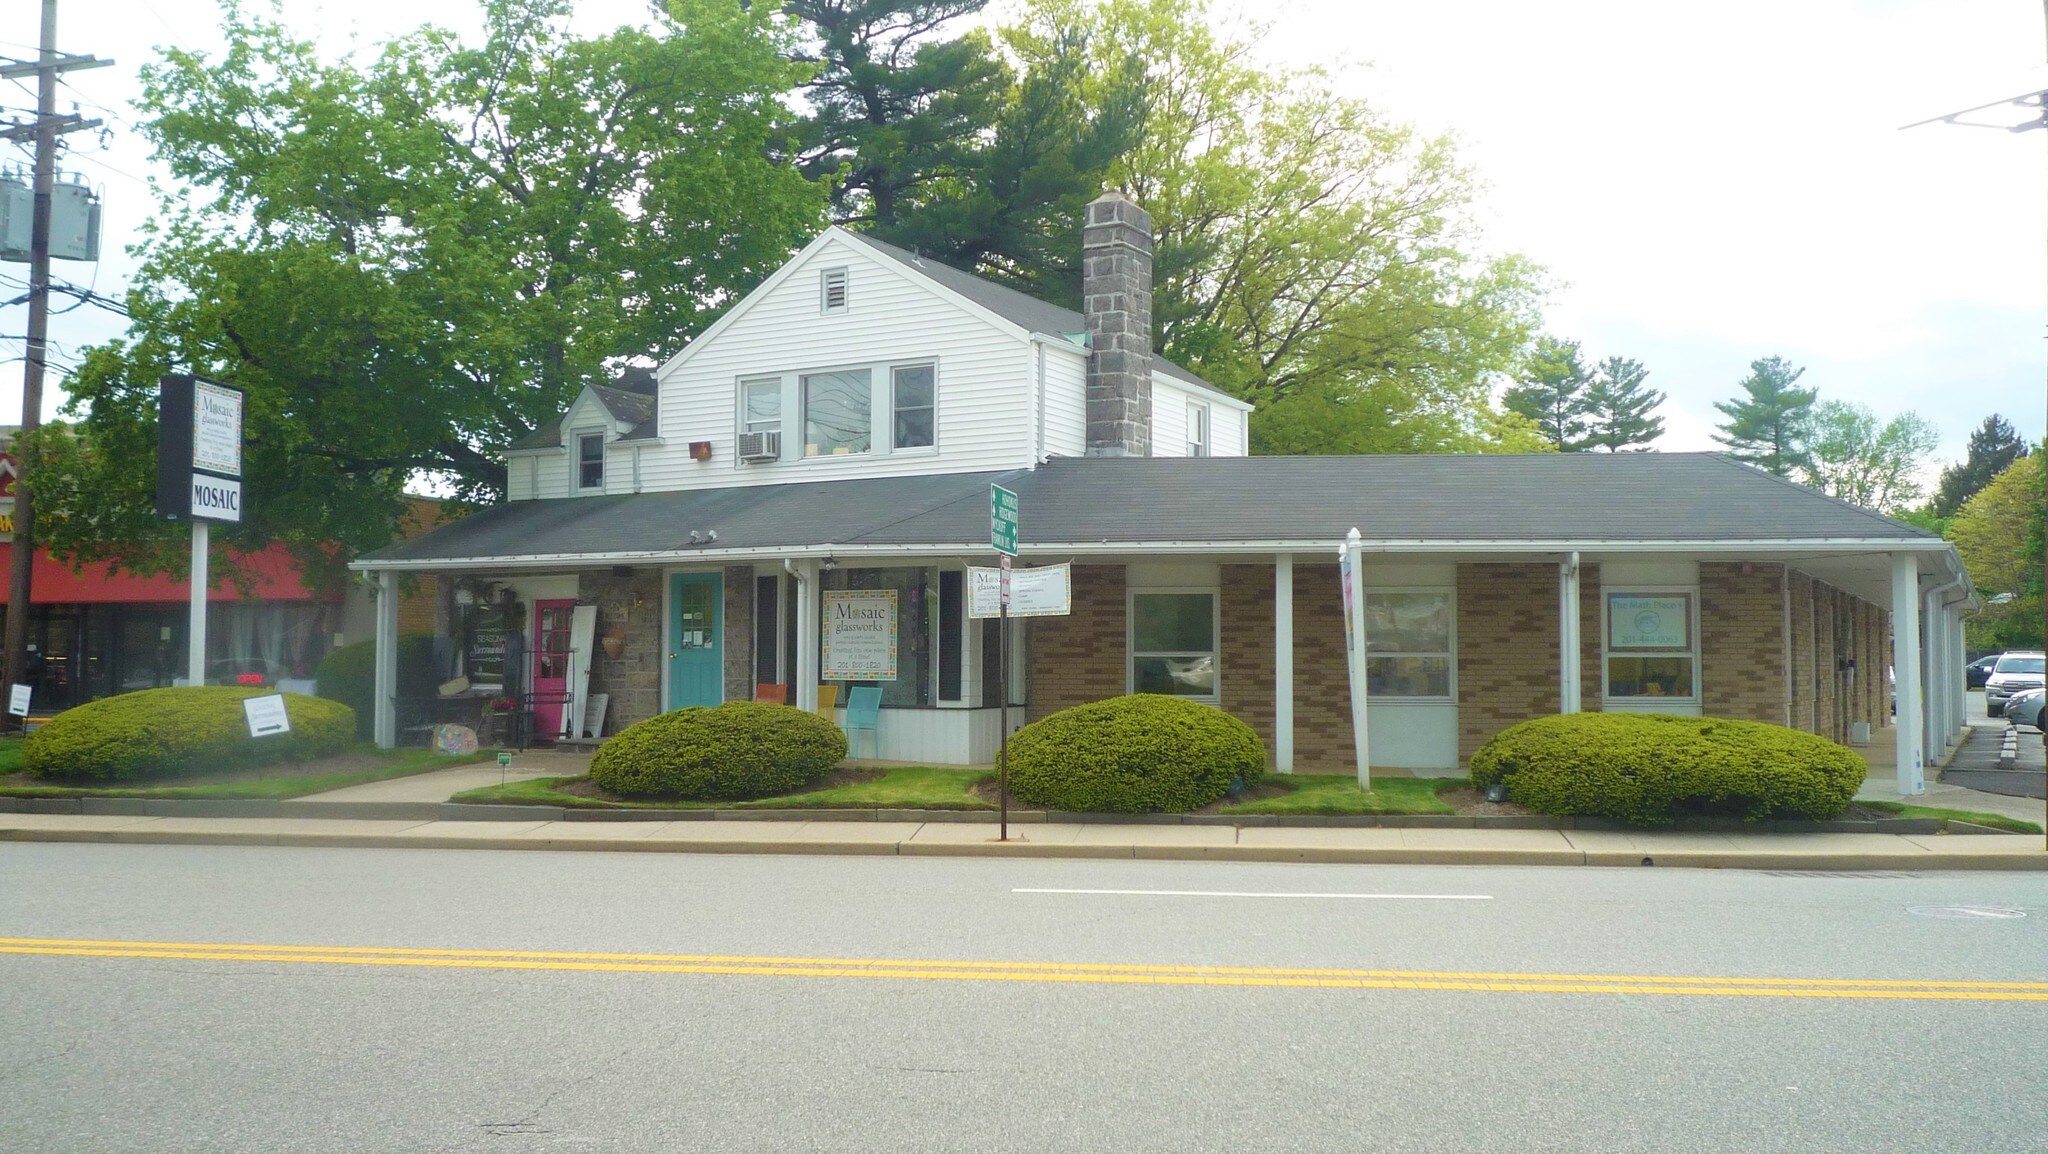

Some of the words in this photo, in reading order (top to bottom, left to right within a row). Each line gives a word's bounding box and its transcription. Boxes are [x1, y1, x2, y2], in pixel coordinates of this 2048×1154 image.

[202, 395, 234, 417] Mosaic
[194, 484, 238, 511] MOSAIC
[835, 602, 886, 619] Mosaic
[1612, 600, 1628, 609] The
[1629, 600, 1651, 609] Math
[1653, 600, 1677, 609] Place
[836, 620, 883, 635] glassworks
[237, 673, 264, 684] OPEN
